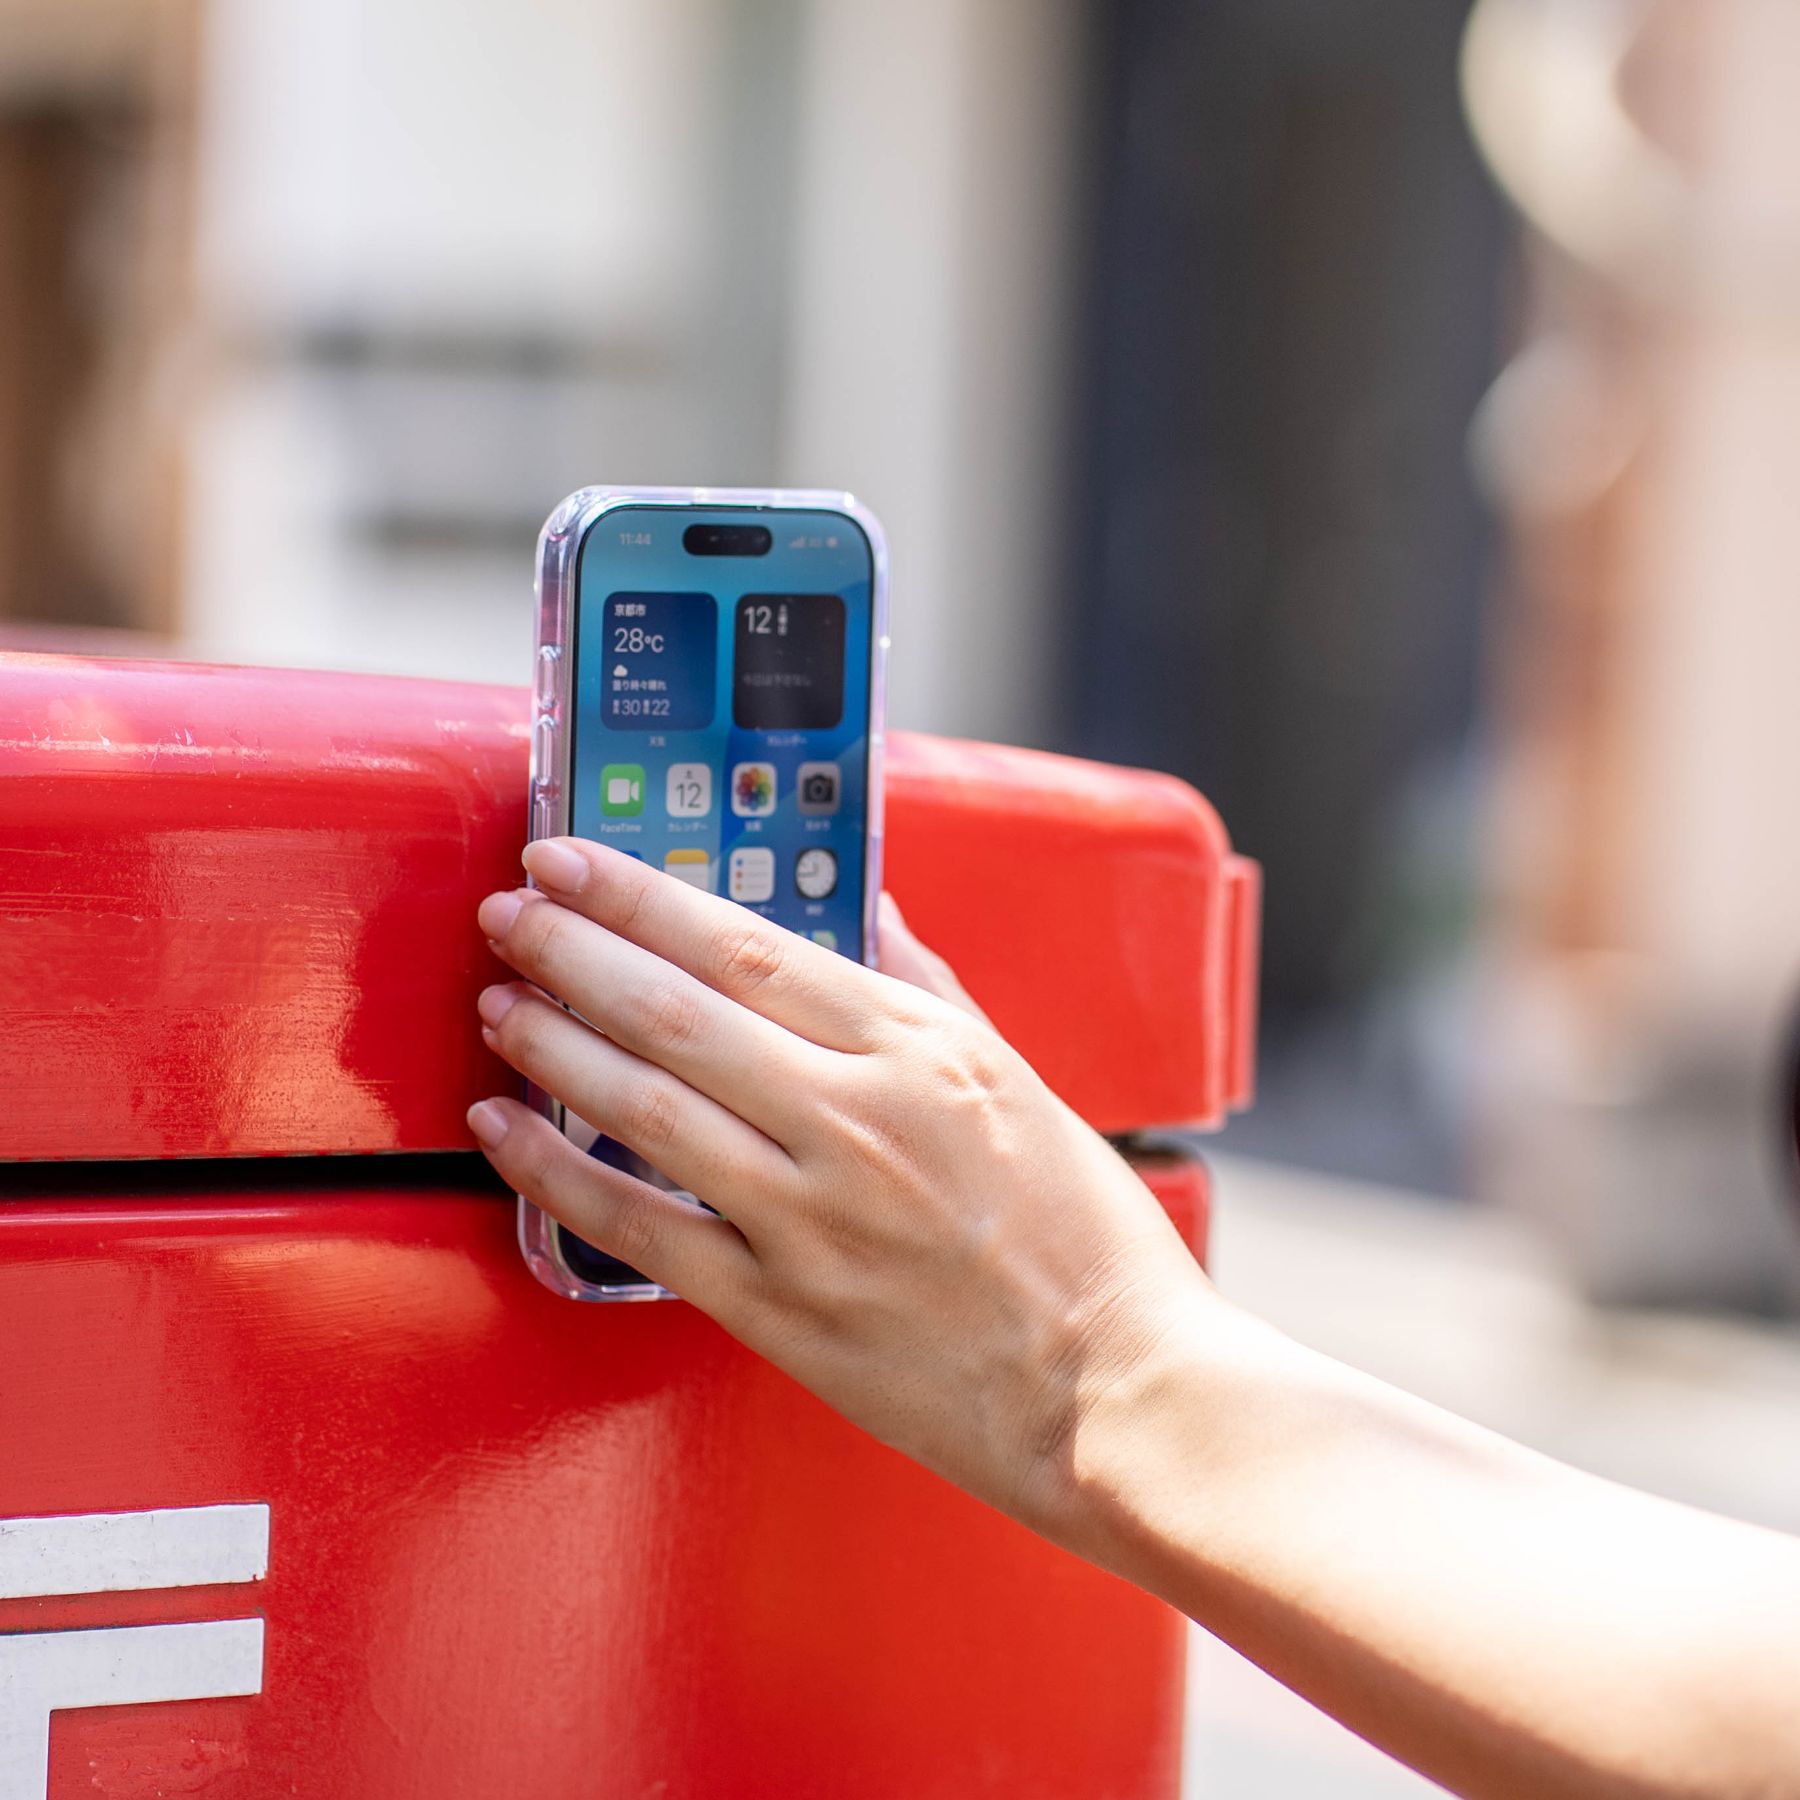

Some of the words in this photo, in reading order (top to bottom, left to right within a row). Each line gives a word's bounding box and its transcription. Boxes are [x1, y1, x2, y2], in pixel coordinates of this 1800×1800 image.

[619, 533, 652, 545] 11:44
[614, 604, 646, 617] 京都市
[744, 605, 773, 634] 12
[614, 627, 664, 653] 28°C
[622, 699, 641, 715] 30
[652, 699, 671, 716] 22
[676, 782, 702, 809] 12
[600, 822, 642, 833] FaceTime
